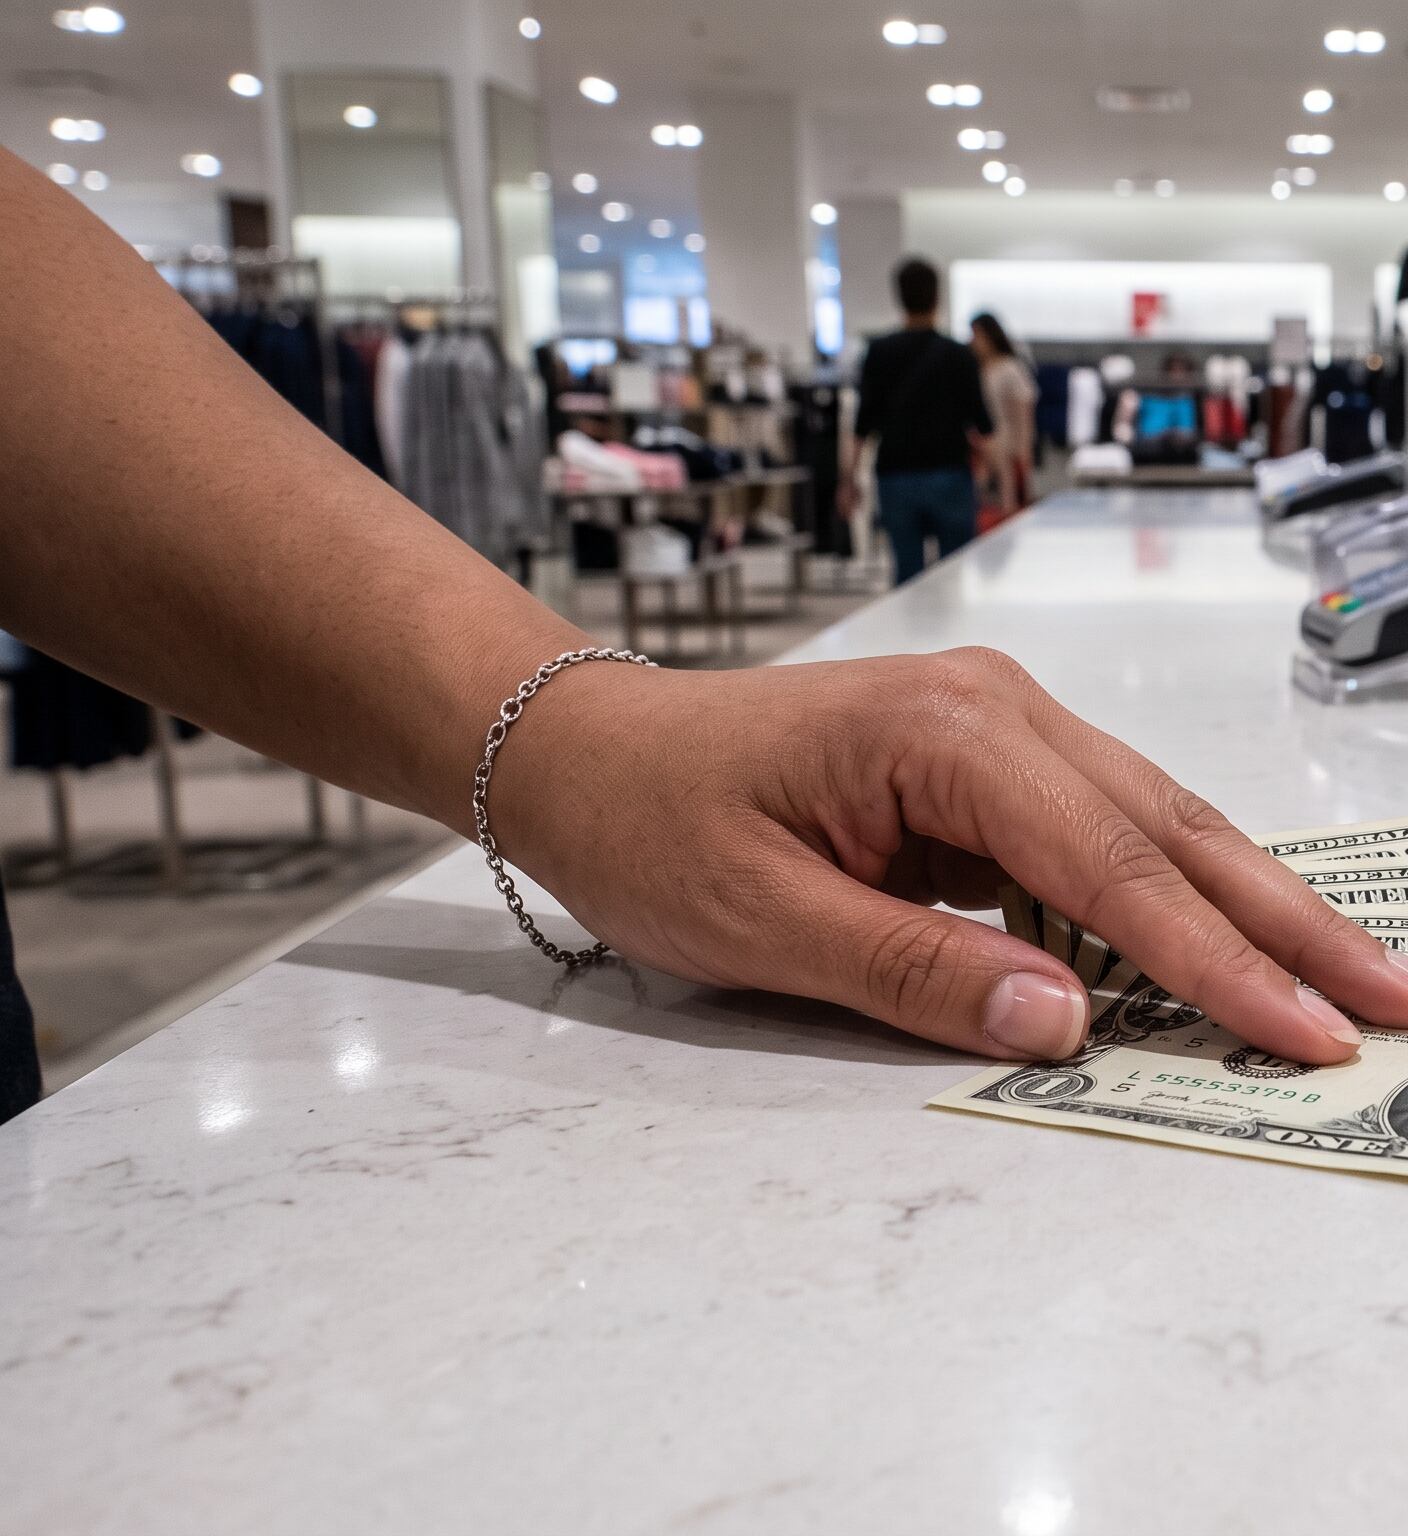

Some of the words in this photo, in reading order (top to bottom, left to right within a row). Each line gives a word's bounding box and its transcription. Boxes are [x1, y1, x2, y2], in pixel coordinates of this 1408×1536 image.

[1184, 1037, 1208, 1048] 5
[1024, 1076, 1072, 1096] 1
[1111, 1082, 1137, 1093] 5
[1128, 1071, 1141, 1081] L
[1301, 1093, 1321, 1104] B
[1265, 1129, 1389, 1156] ONE
